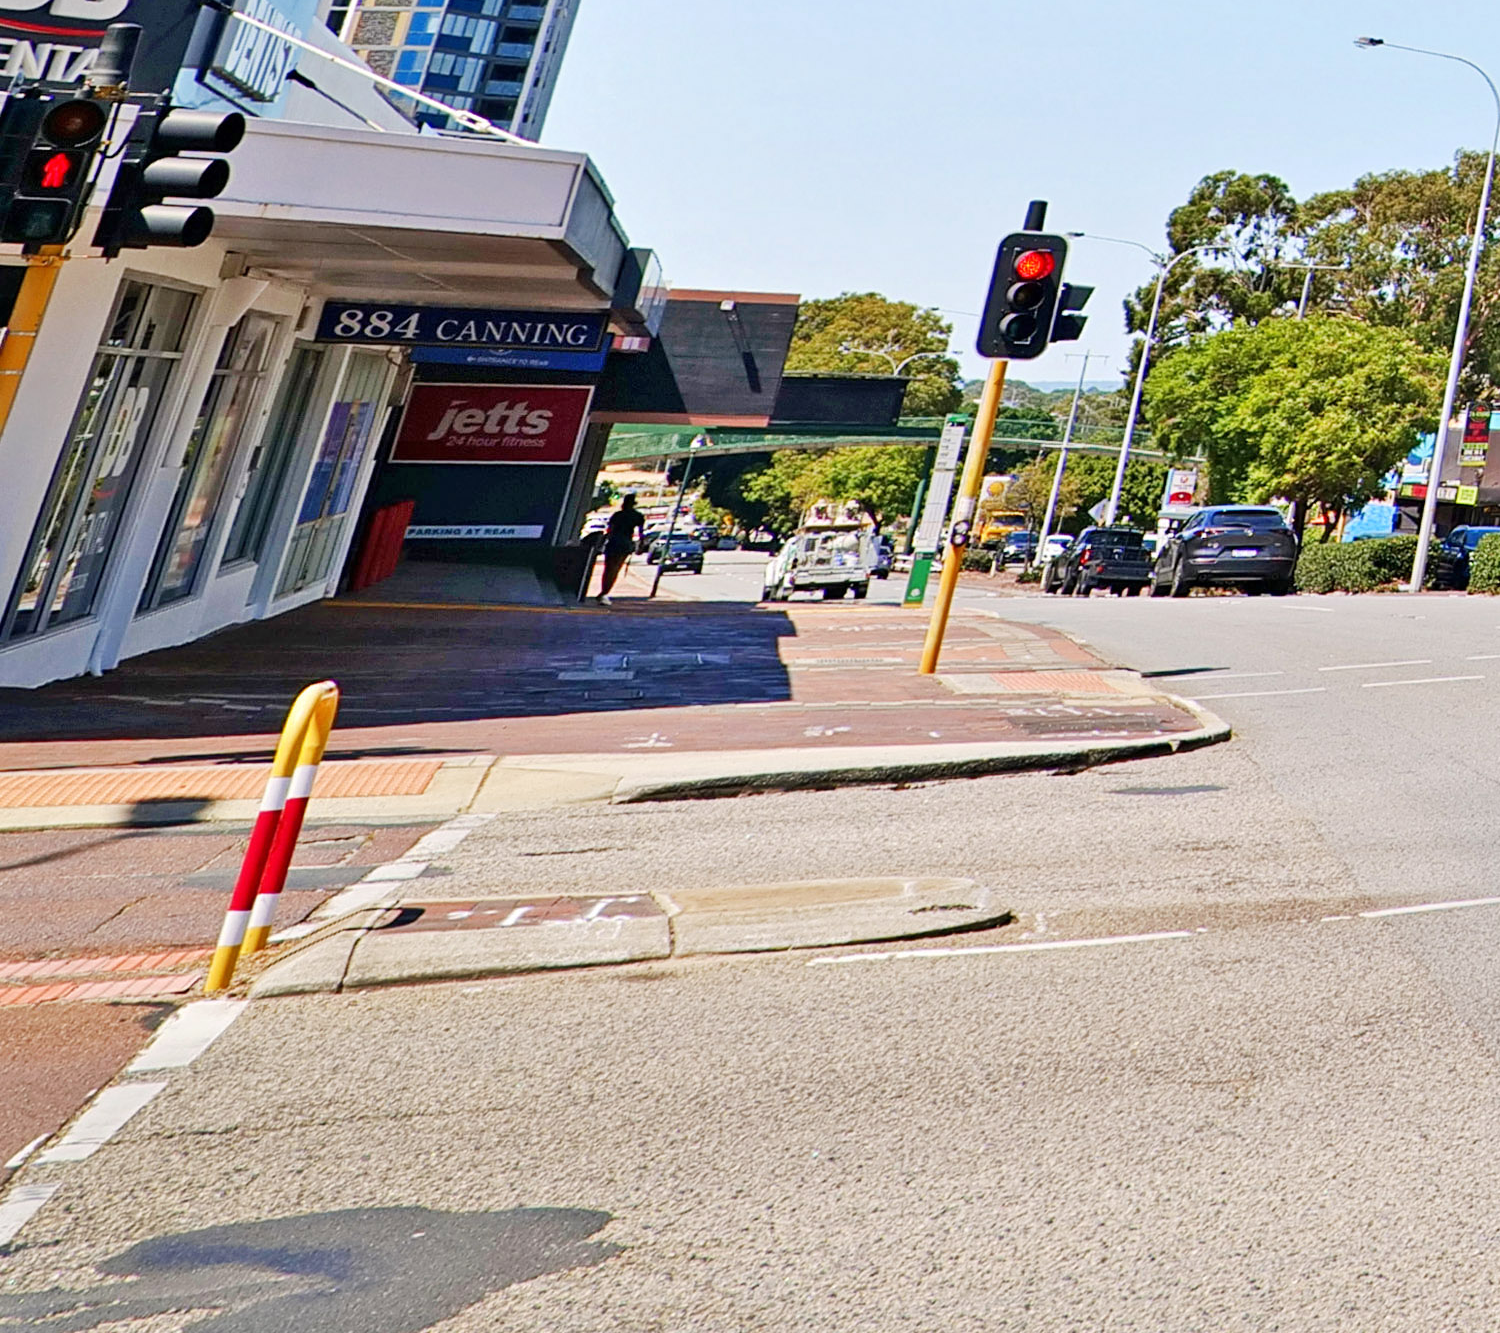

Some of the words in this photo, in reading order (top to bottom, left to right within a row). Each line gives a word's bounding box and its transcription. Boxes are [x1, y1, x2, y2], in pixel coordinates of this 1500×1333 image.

[334, 309, 420, 339] 884
[436, 319, 588, 345] CANNING
[426, 400, 553, 440] jetts
[446, 436, 465, 446] 24
[466, 436, 500, 446] hour
[501, 436, 547, 447] fitness
[408, 528, 459, 536] PARKING
[463, 528, 481, 536] AT
